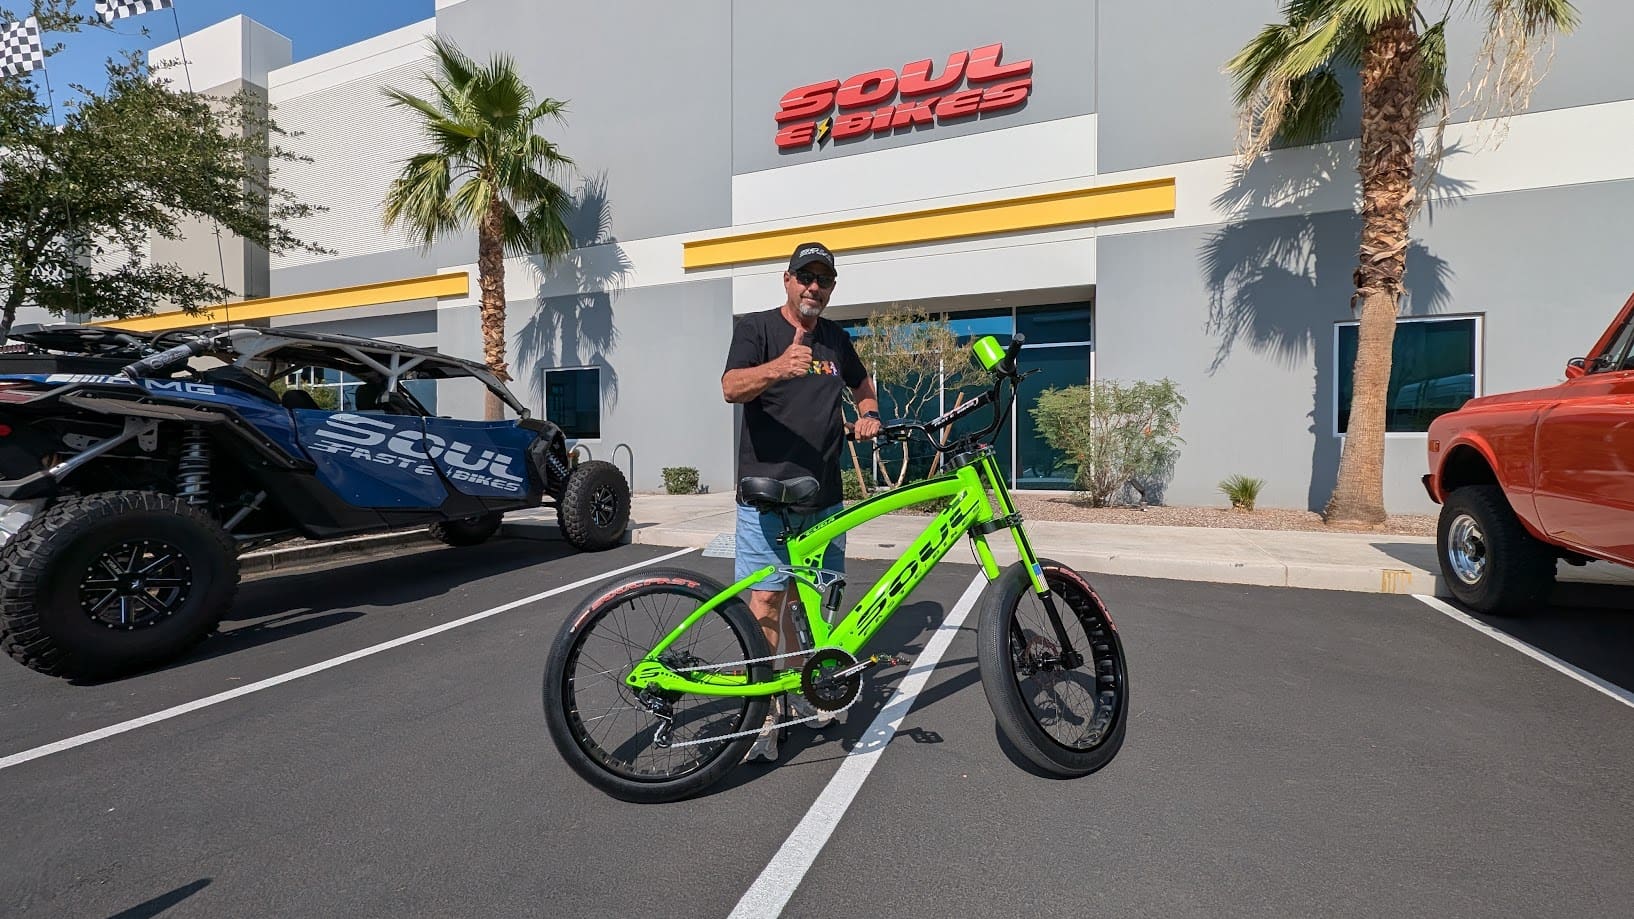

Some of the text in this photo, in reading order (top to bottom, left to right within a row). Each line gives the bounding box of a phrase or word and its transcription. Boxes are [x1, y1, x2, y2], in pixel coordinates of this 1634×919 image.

[774, 43, 1033, 121] SOUL
[831, 78, 1033, 140] BIKES
[308, 439, 416, 469] FAST
[452, 469, 521, 492] BIKES
[315, 413, 524, 482] SOUL
[857, 499, 980, 636] SOUL
